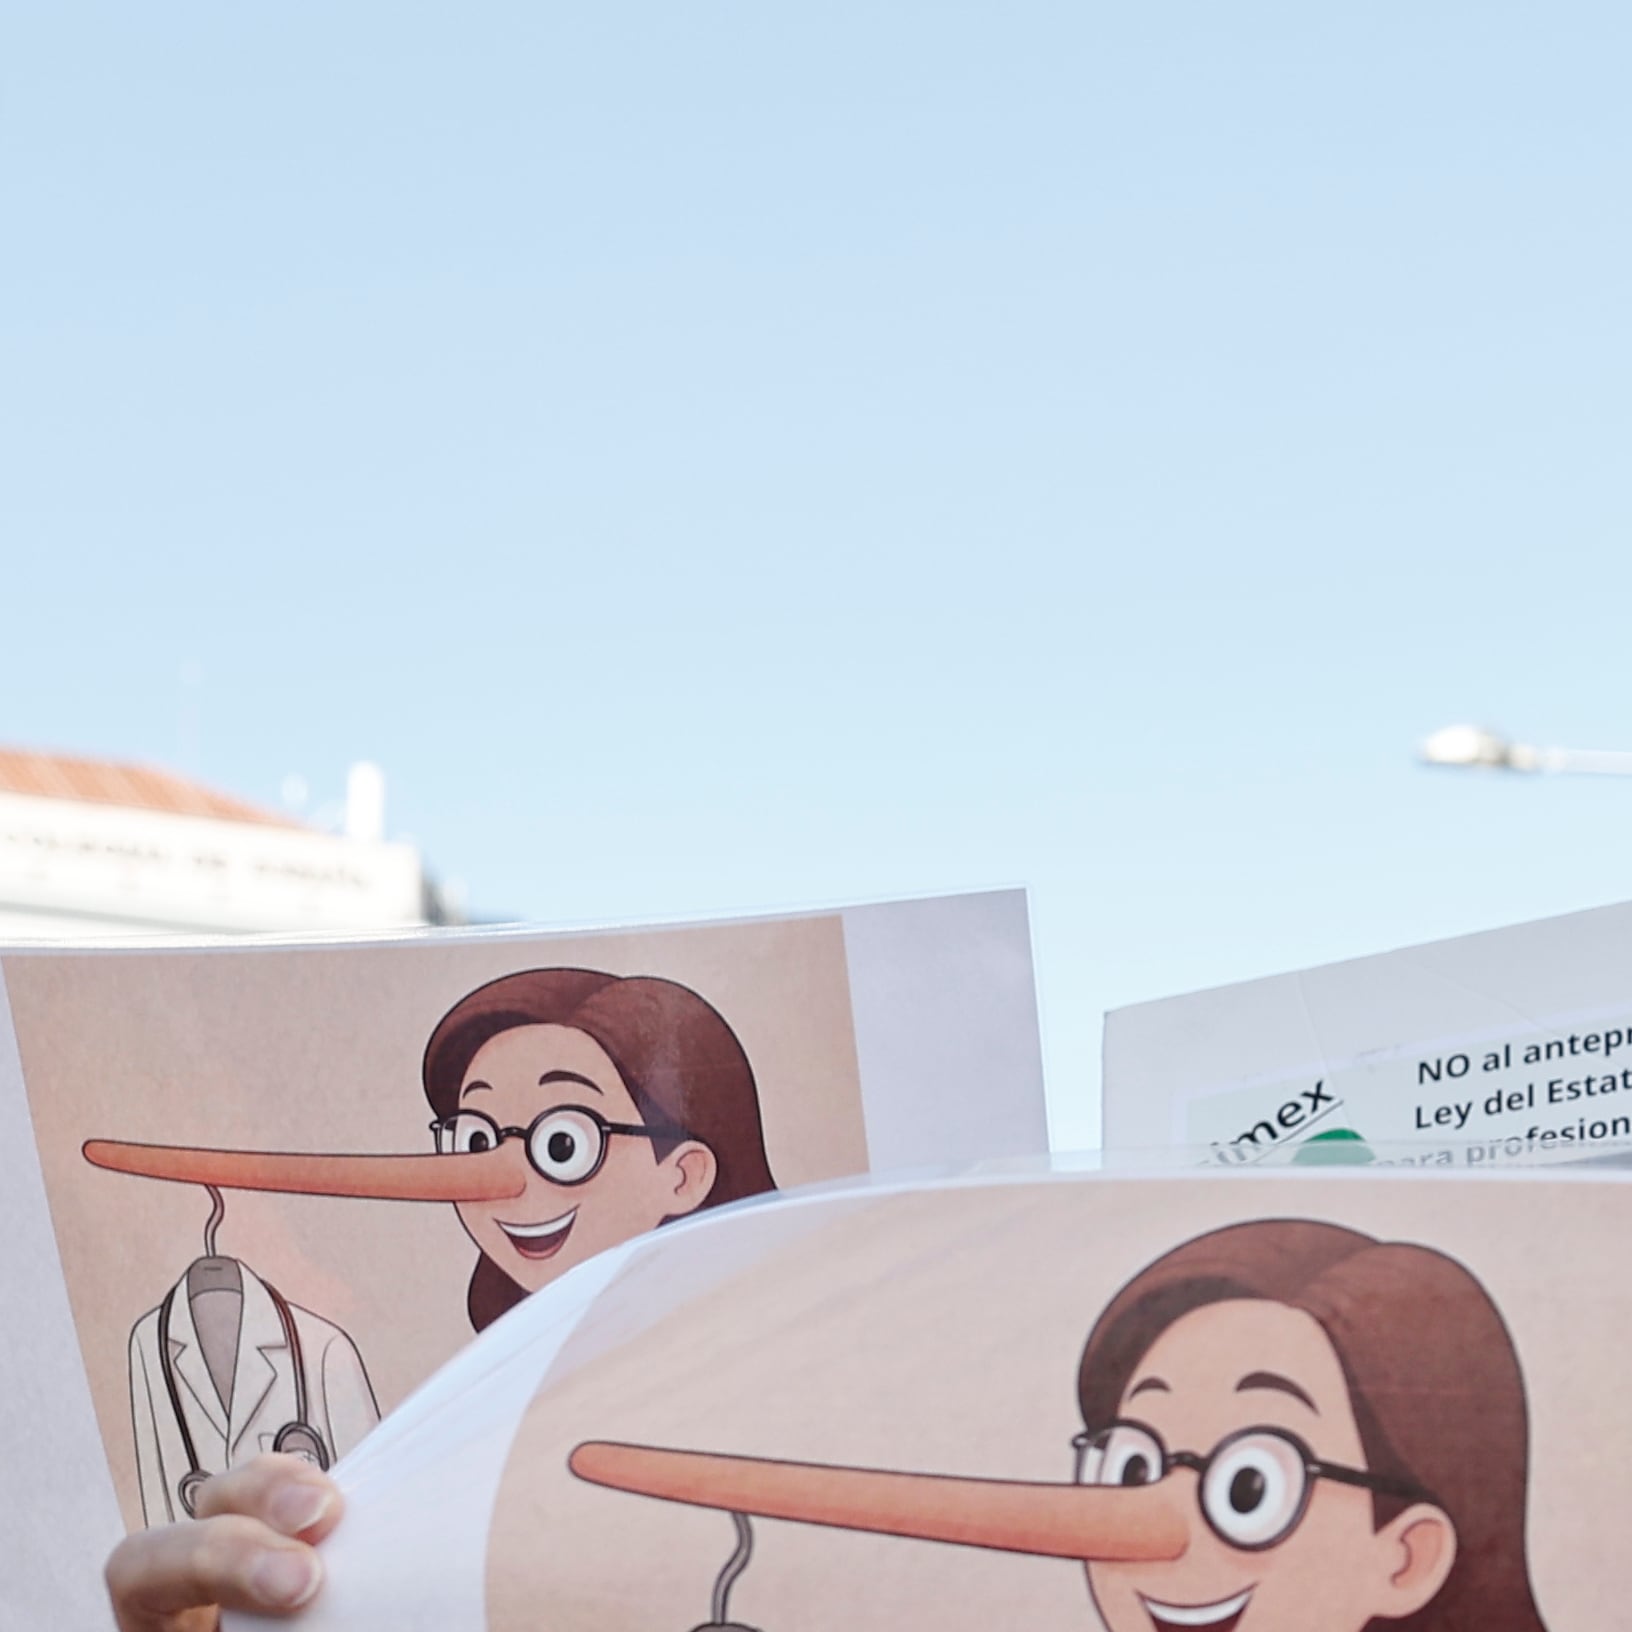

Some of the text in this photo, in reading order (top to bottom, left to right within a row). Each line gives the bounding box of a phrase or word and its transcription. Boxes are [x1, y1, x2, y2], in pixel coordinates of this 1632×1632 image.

[1418, 1054, 1470, 1084] NO
[1482, 1043, 1511, 1073] al
[1415, 1101, 1473, 1130] Ley
[1484, 1083, 1534, 1116] del
